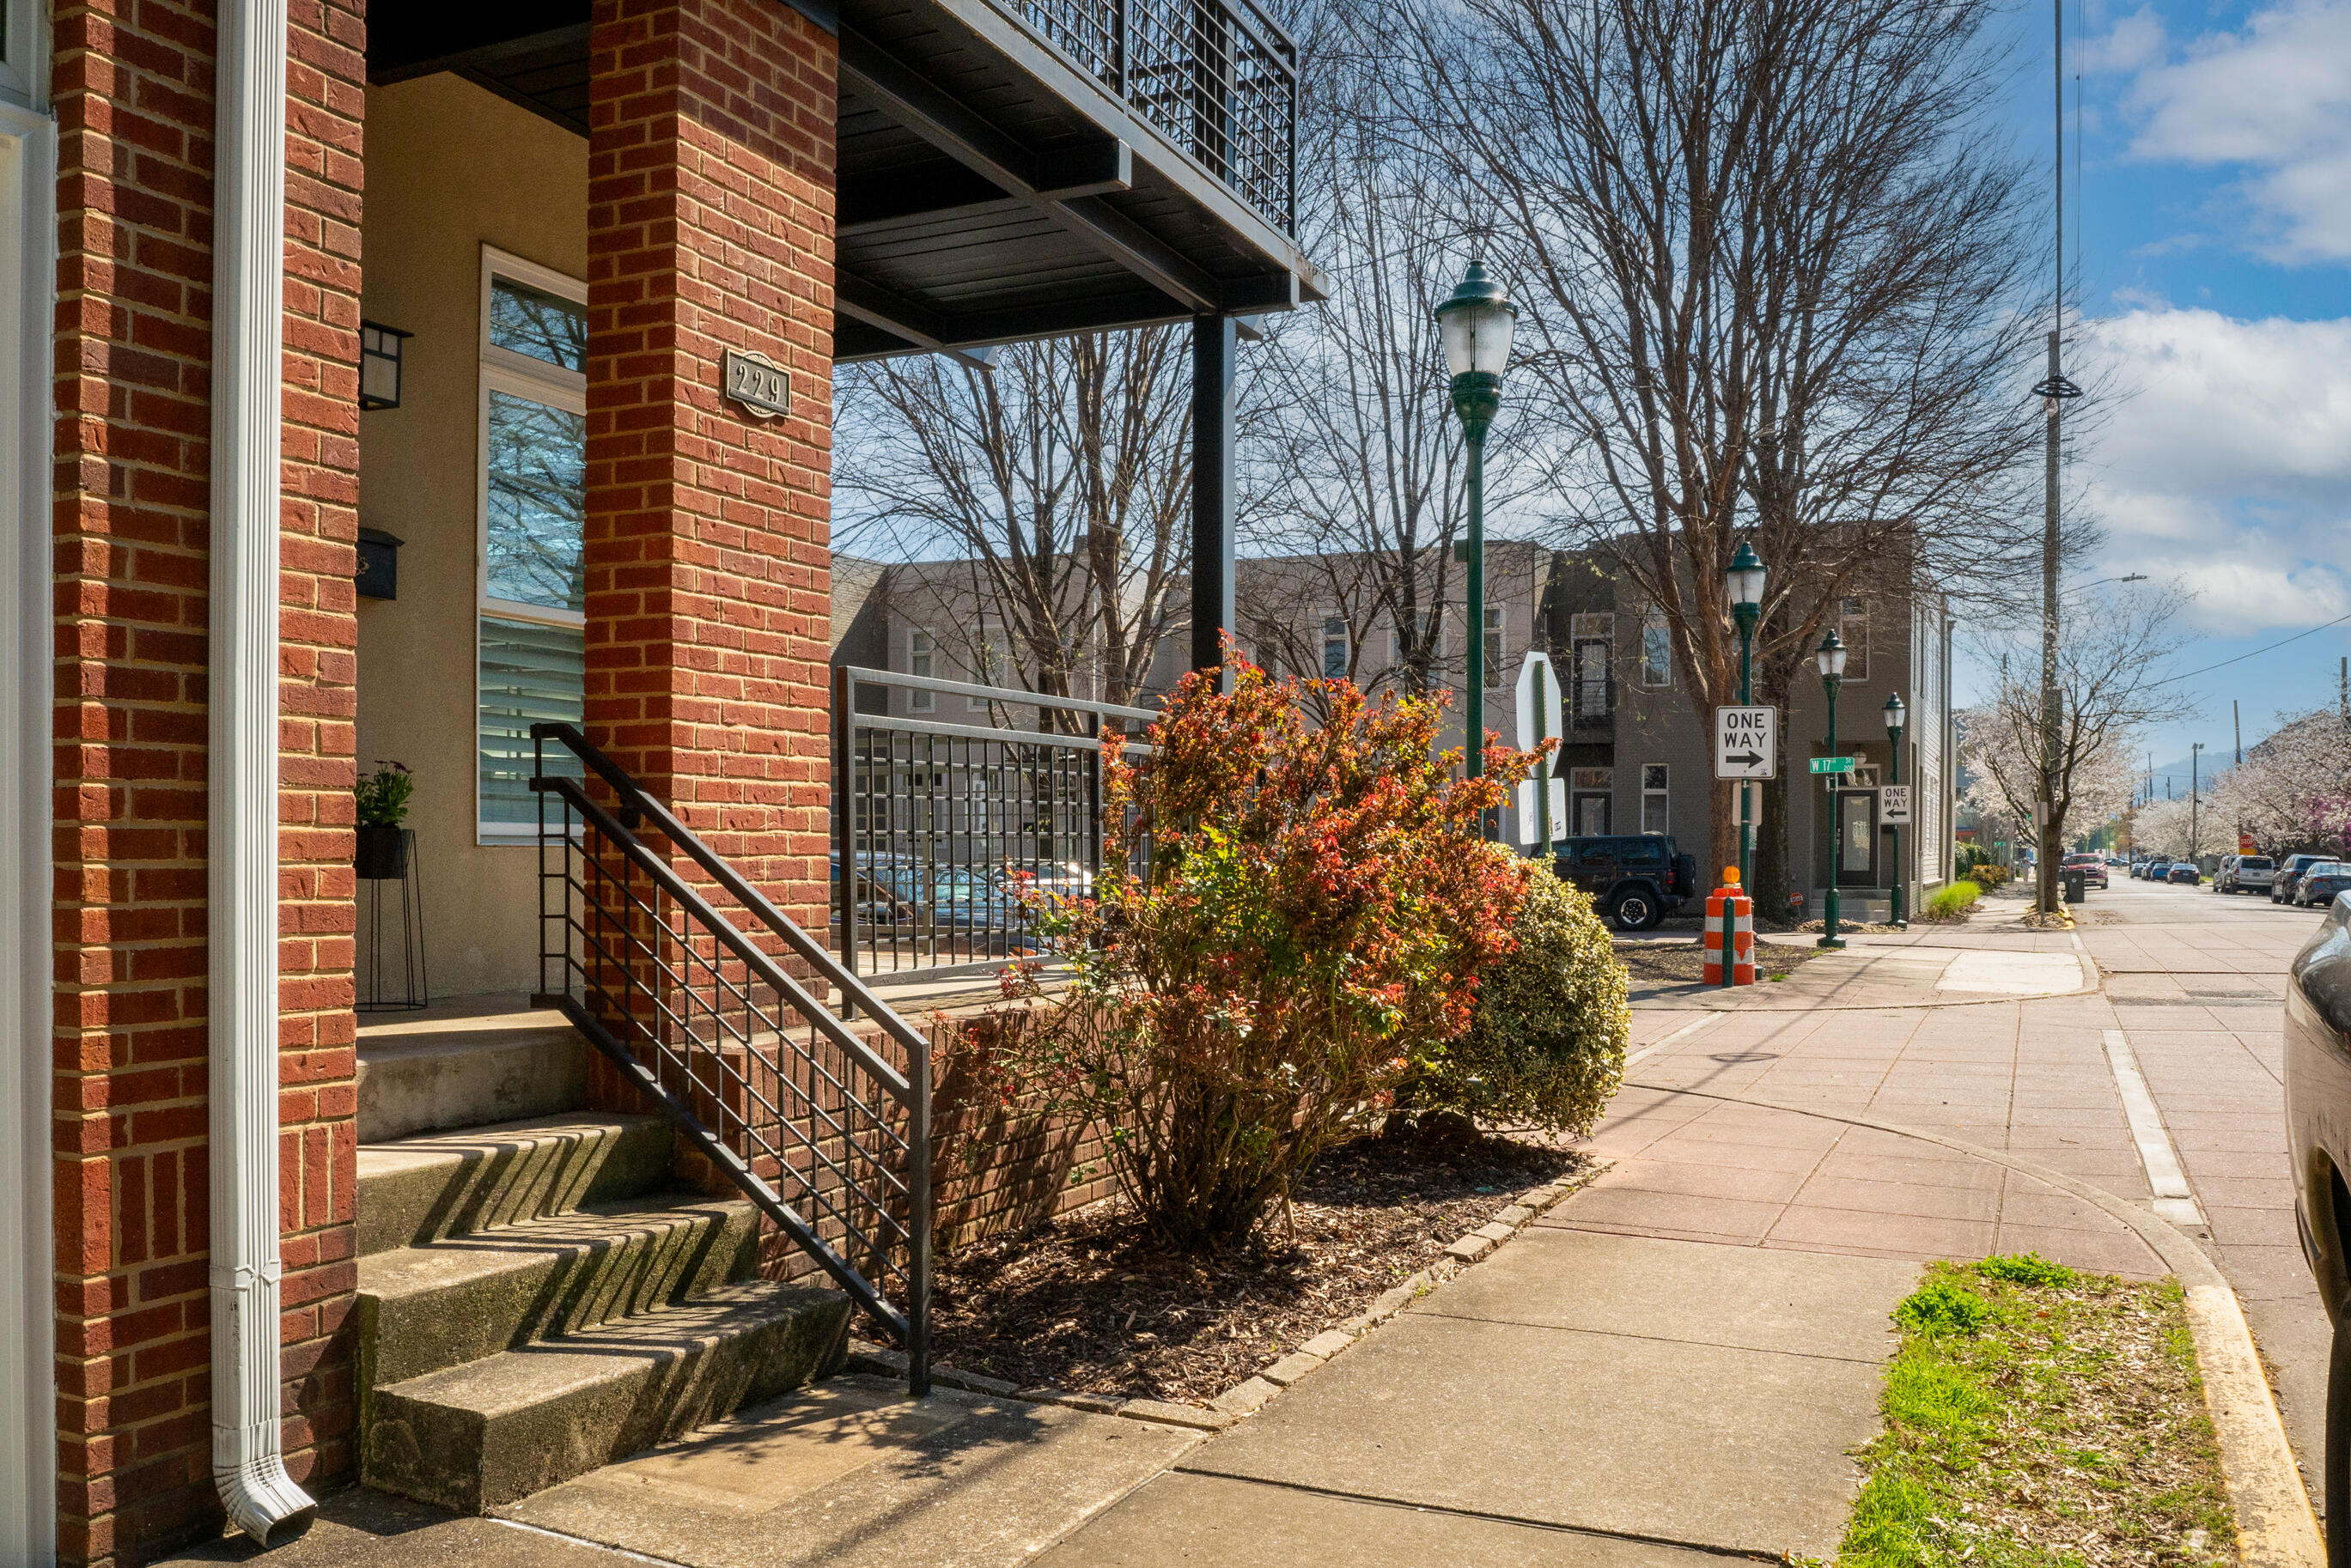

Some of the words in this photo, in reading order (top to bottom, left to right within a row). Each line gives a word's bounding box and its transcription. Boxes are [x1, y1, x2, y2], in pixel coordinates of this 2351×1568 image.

[737, 363, 780, 404] 229
[1727, 713, 1764, 728] ONE
[1725, 732, 1767, 748] WAY
[1812, 760, 1819, 771] W
[1885, 787, 1907, 797] ONE
[1884, 798, 1908, 807] WAY
